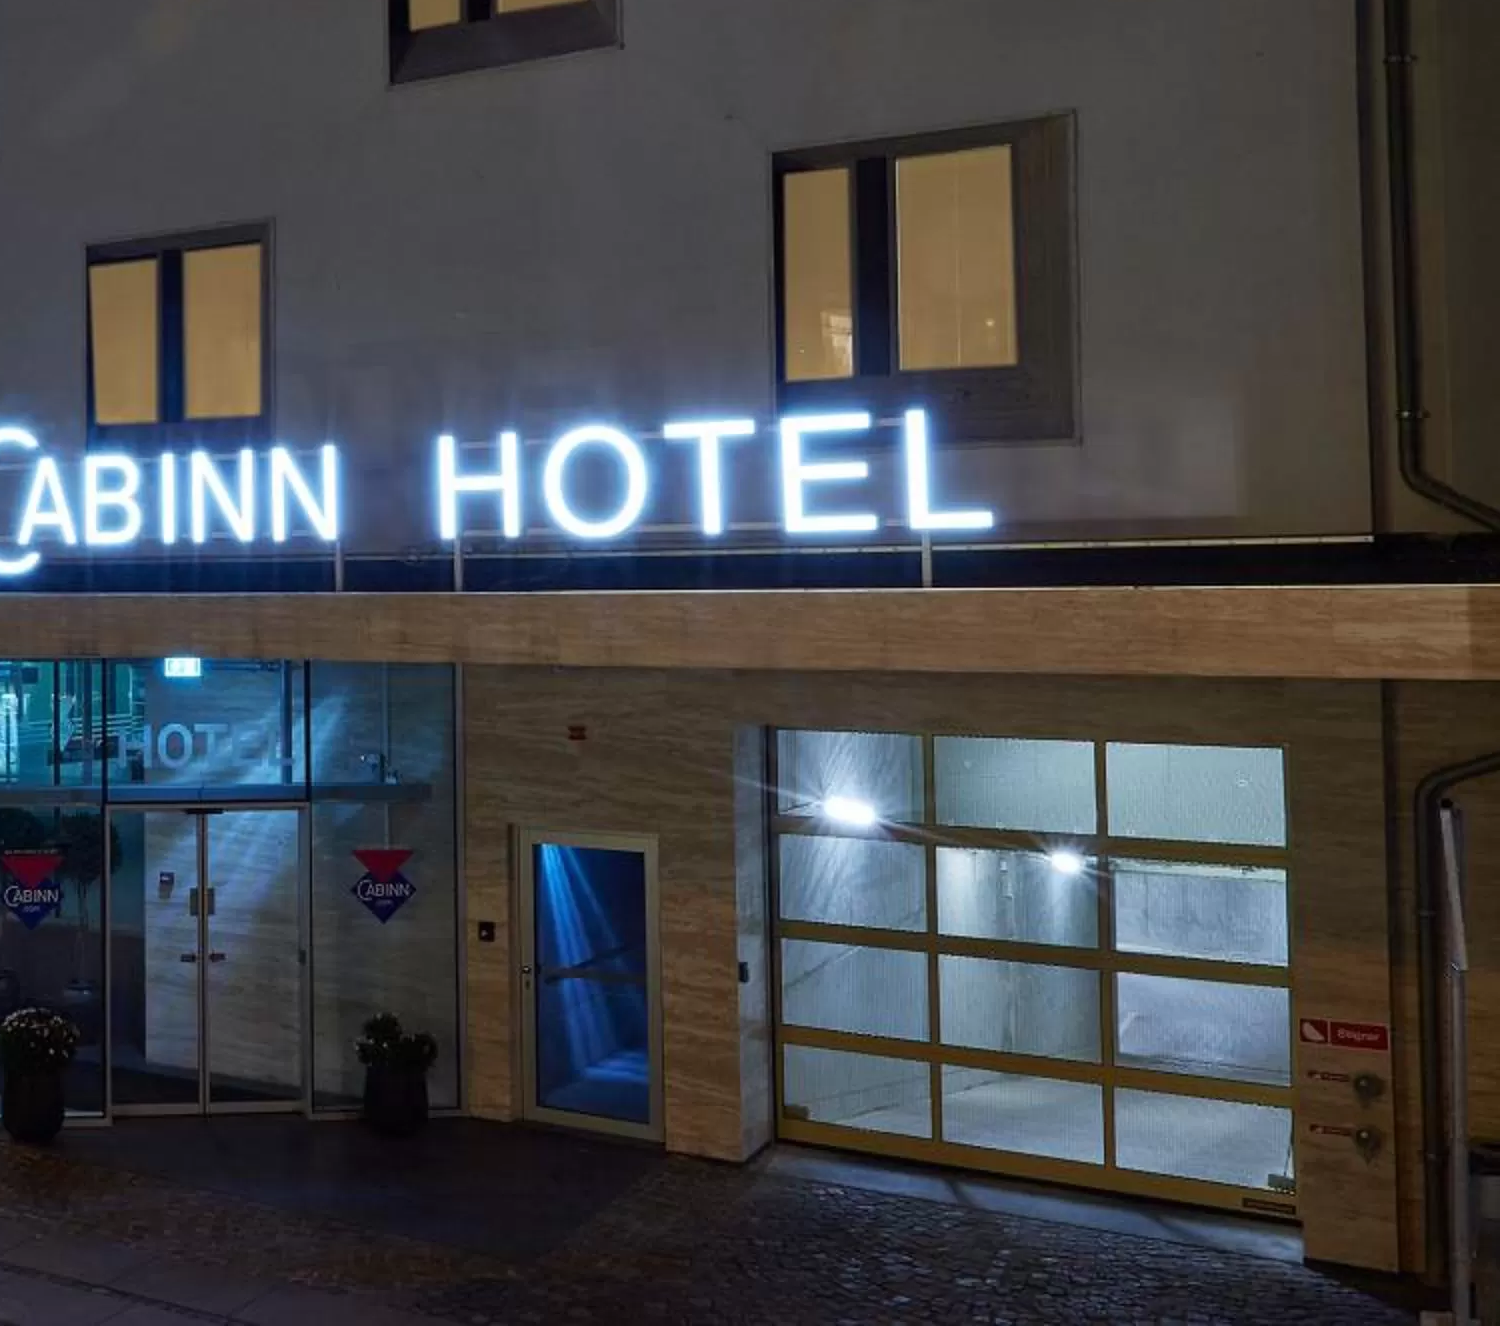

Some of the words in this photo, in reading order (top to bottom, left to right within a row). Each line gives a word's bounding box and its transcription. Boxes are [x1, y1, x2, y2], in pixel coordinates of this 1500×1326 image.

[436, 409, 996, 540] HOTEL
[117, 722, 294, 769] HOTEL
[3, 885, 59, 907] CABINN
[357, 879, 411, 901] CABINN
